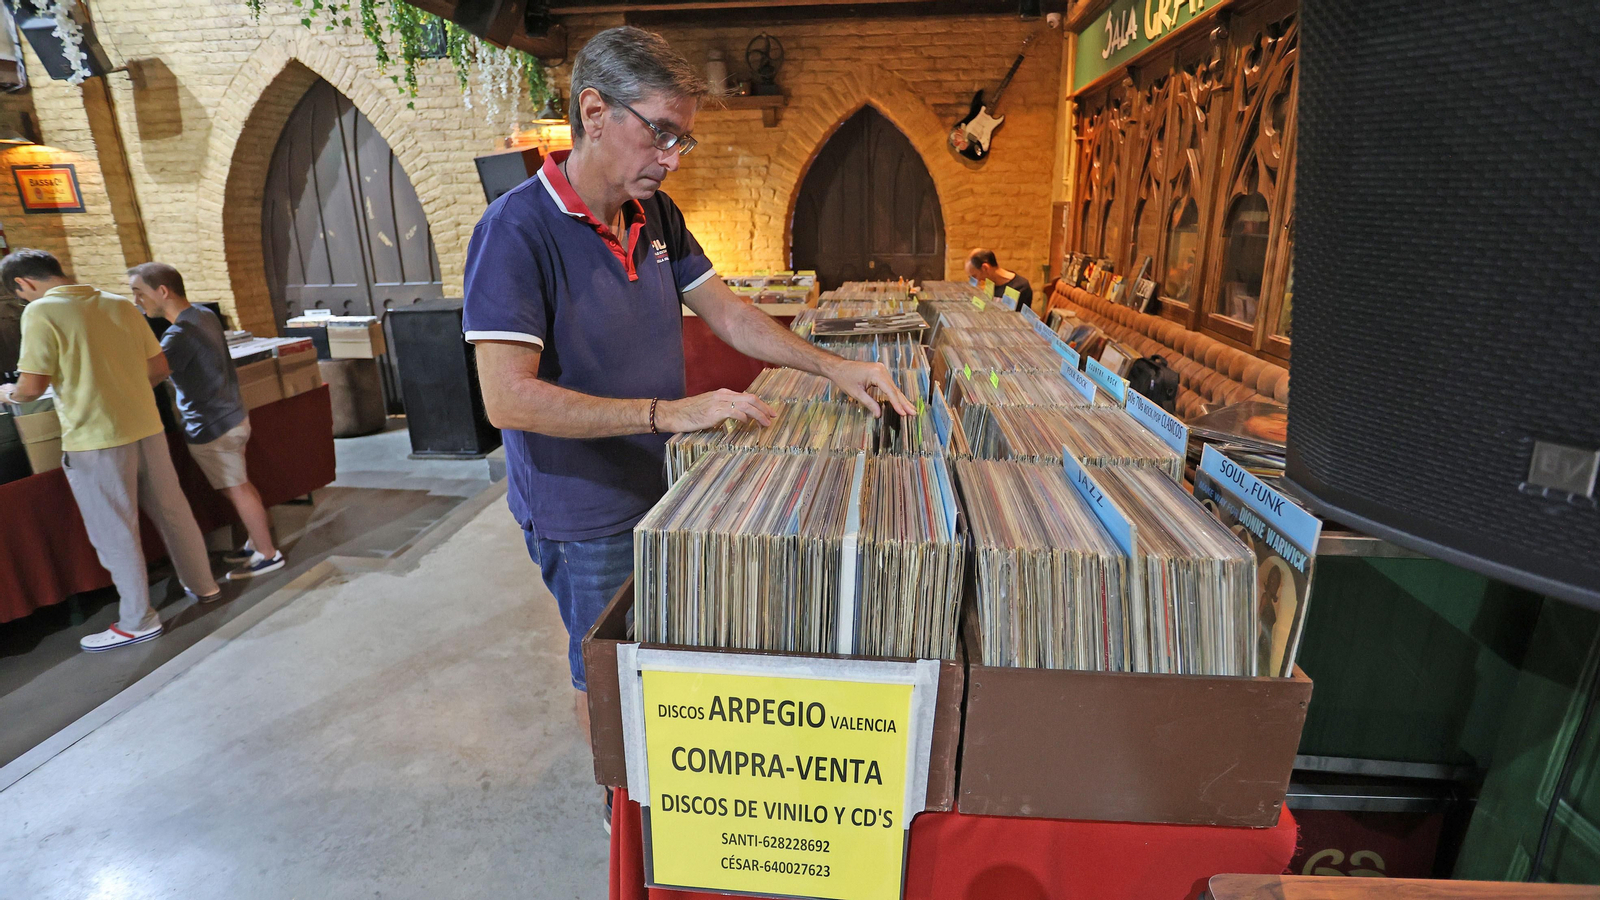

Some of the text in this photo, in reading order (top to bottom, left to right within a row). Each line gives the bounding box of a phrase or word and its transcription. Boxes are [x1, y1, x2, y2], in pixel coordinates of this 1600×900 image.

[1076, 374, 1088, 390] ROCK
[1088, 362, 1118, 387] COUNTRY ROCK
[1161, 413, 1184, 440] CLASICOS
[1078, 469, 1104, 508] JAZZ
[1220, 459, 1285, 517] SOUL, FUNK
[1198, 480, 1308, 573] MAKE WAY FOR DIONNE WARWICK
[658, 695, 897, 733] DISCOS ARPEGIO VALENCIA
[671, 746, 883, 786] COMPRA-VENTA
[661, 793, 893, 829] DISCOS DE VINILO Y CD'S
[721, 832, 830, 853] SANTI-628228692
[721, 855, 831, 877] CÉSAR-640027623
